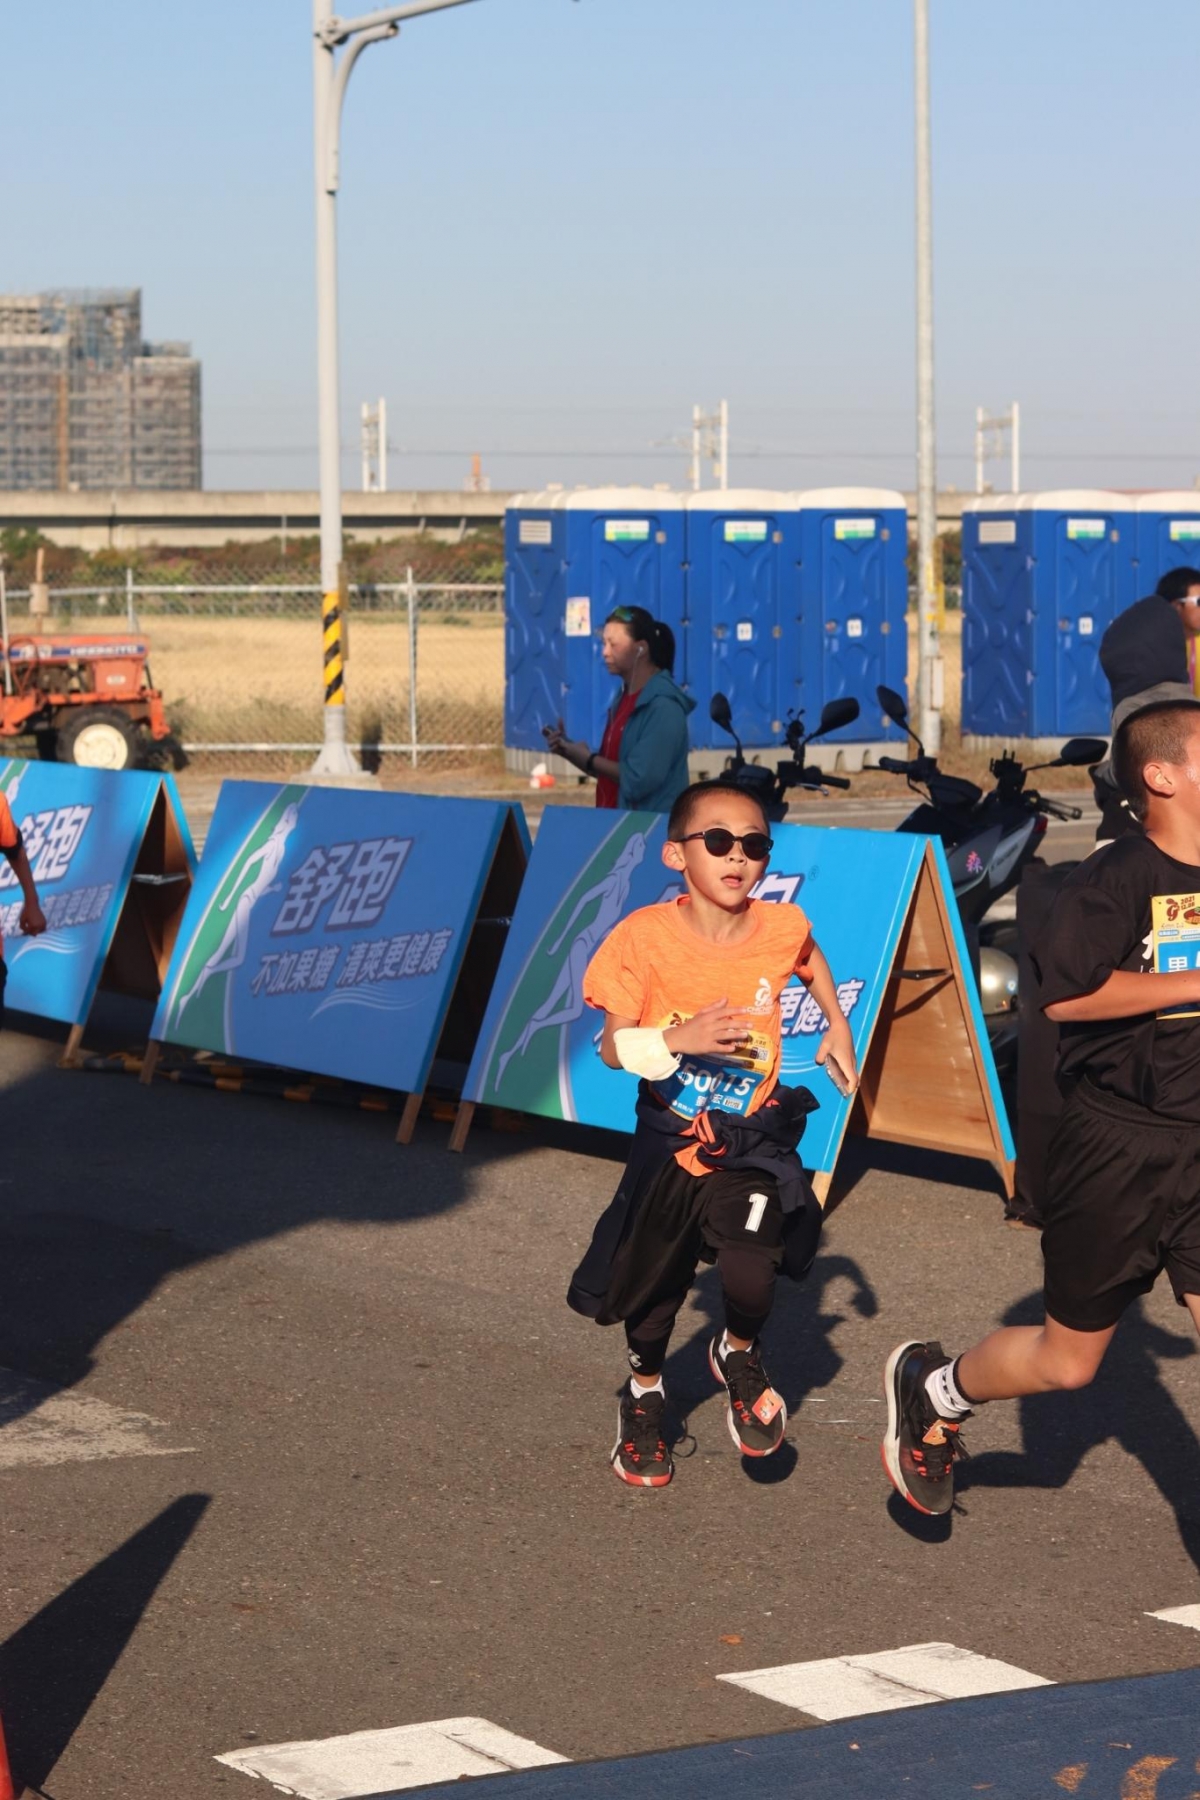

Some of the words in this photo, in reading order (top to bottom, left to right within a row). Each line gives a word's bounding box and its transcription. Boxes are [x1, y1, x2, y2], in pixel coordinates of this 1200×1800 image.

[271, 837, 413, 936] 舒跑
[966, 851, 983, 873] 森
[252, 946, 341, 996] 不加果糖
[336, 929, 452, 987] 清爽更健康
[745, 1193, 768, 1232] 1
